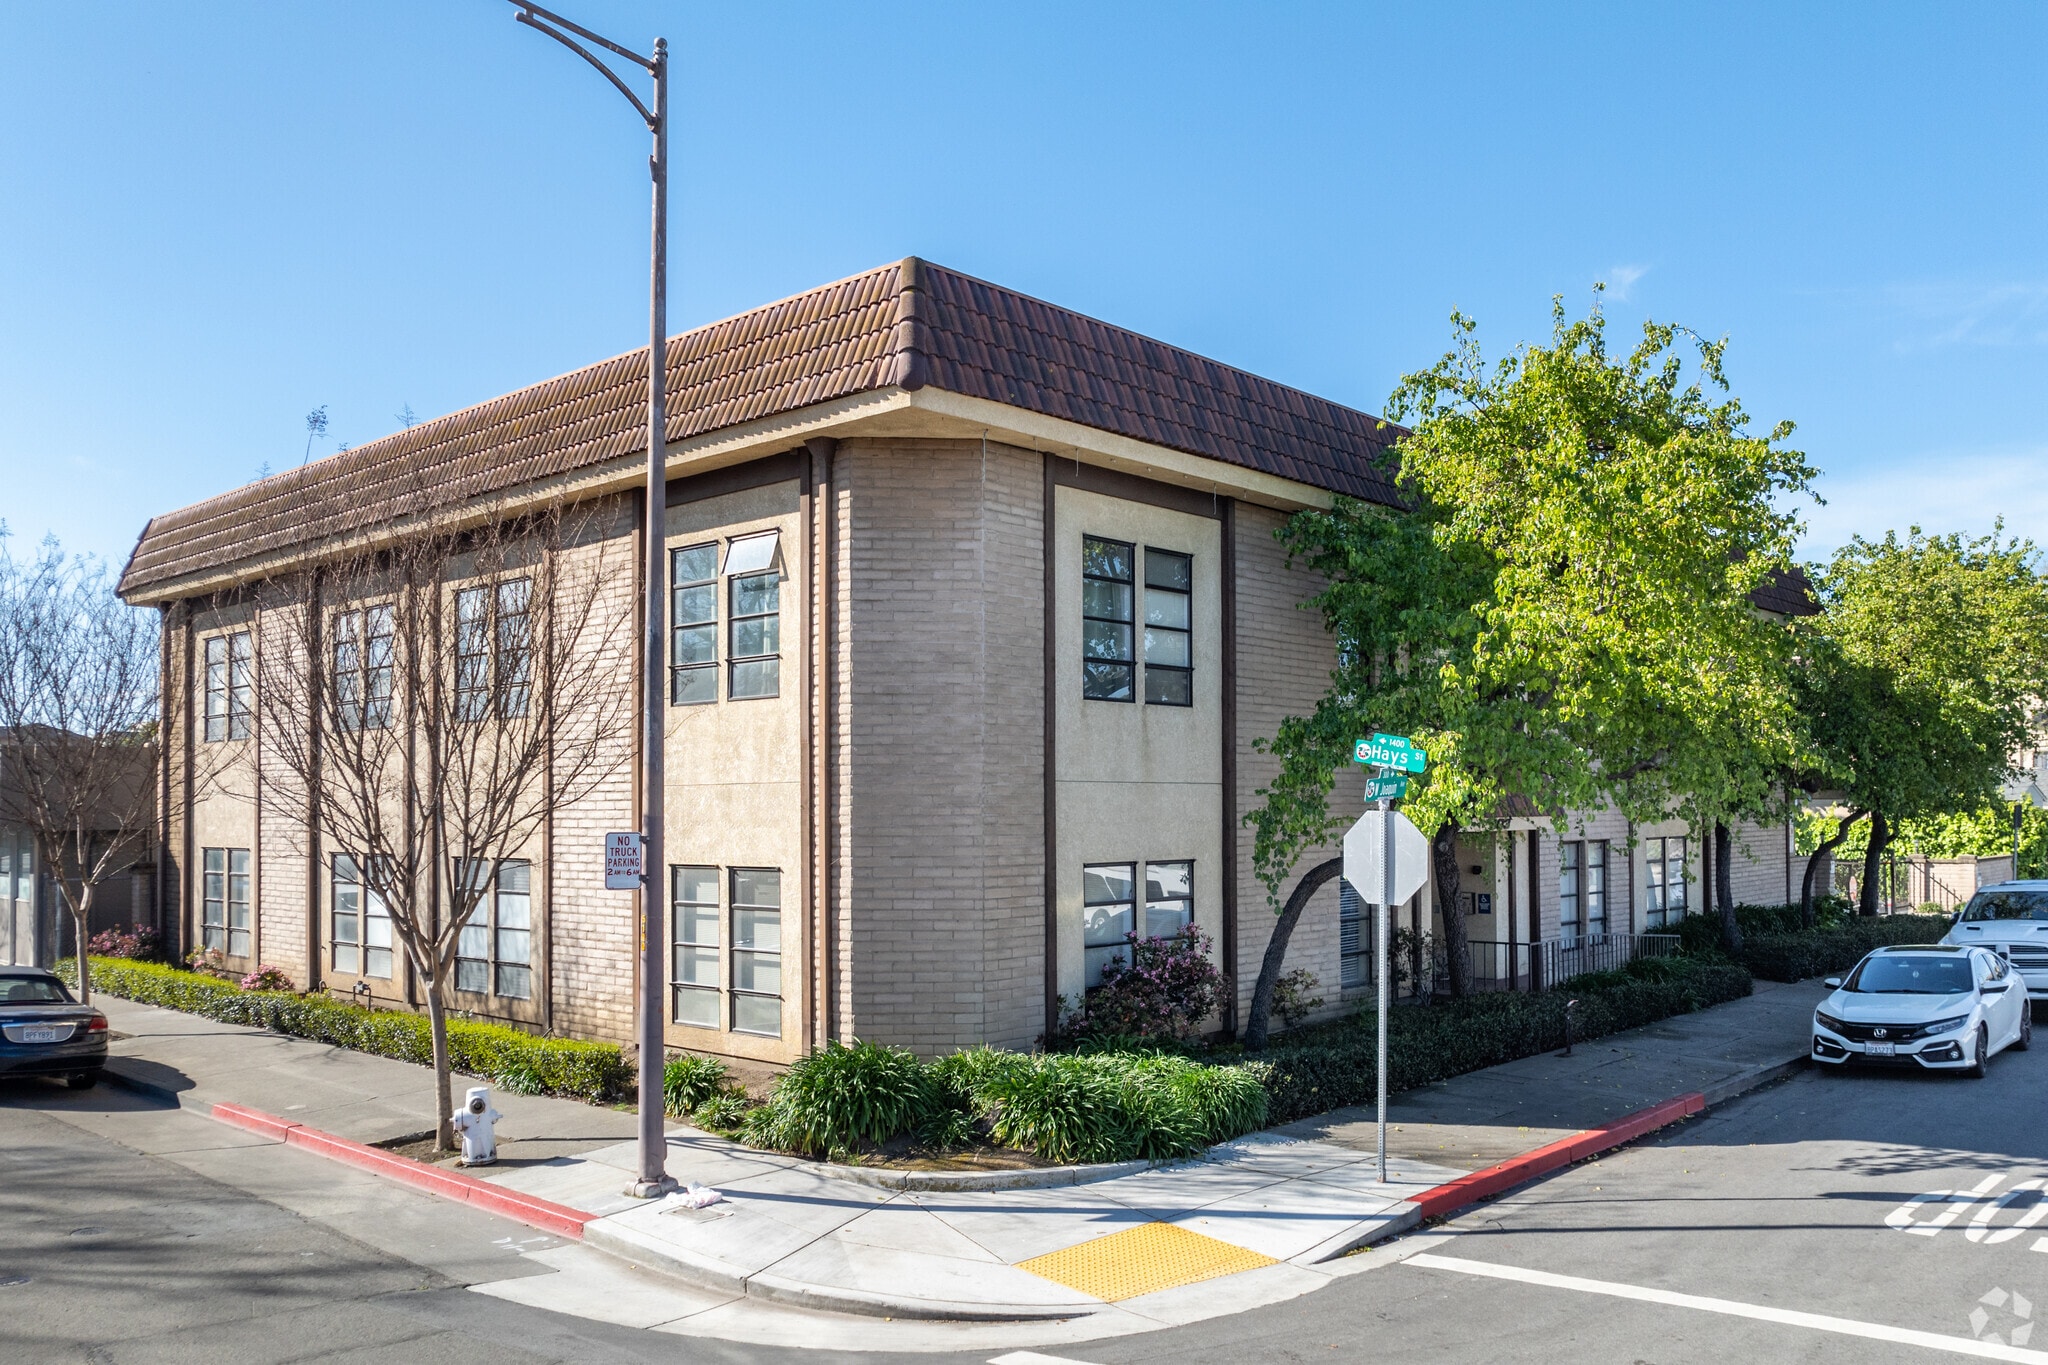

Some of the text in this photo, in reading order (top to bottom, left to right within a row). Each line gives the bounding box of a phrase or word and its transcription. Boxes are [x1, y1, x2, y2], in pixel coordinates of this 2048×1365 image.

[1389, 738, 1405, 748] 1400
[1371, 744, 1424, 766] Hays St
[1380, 781, 1398, 796] Joaquin
[617, 836, 630, 846] NO
[610, 847, 638, 857] TRUCK
[608, 857, 640, 867] PARKING
[607, 868, 613, 876] 2
[626, 868, 632, 876] 6
